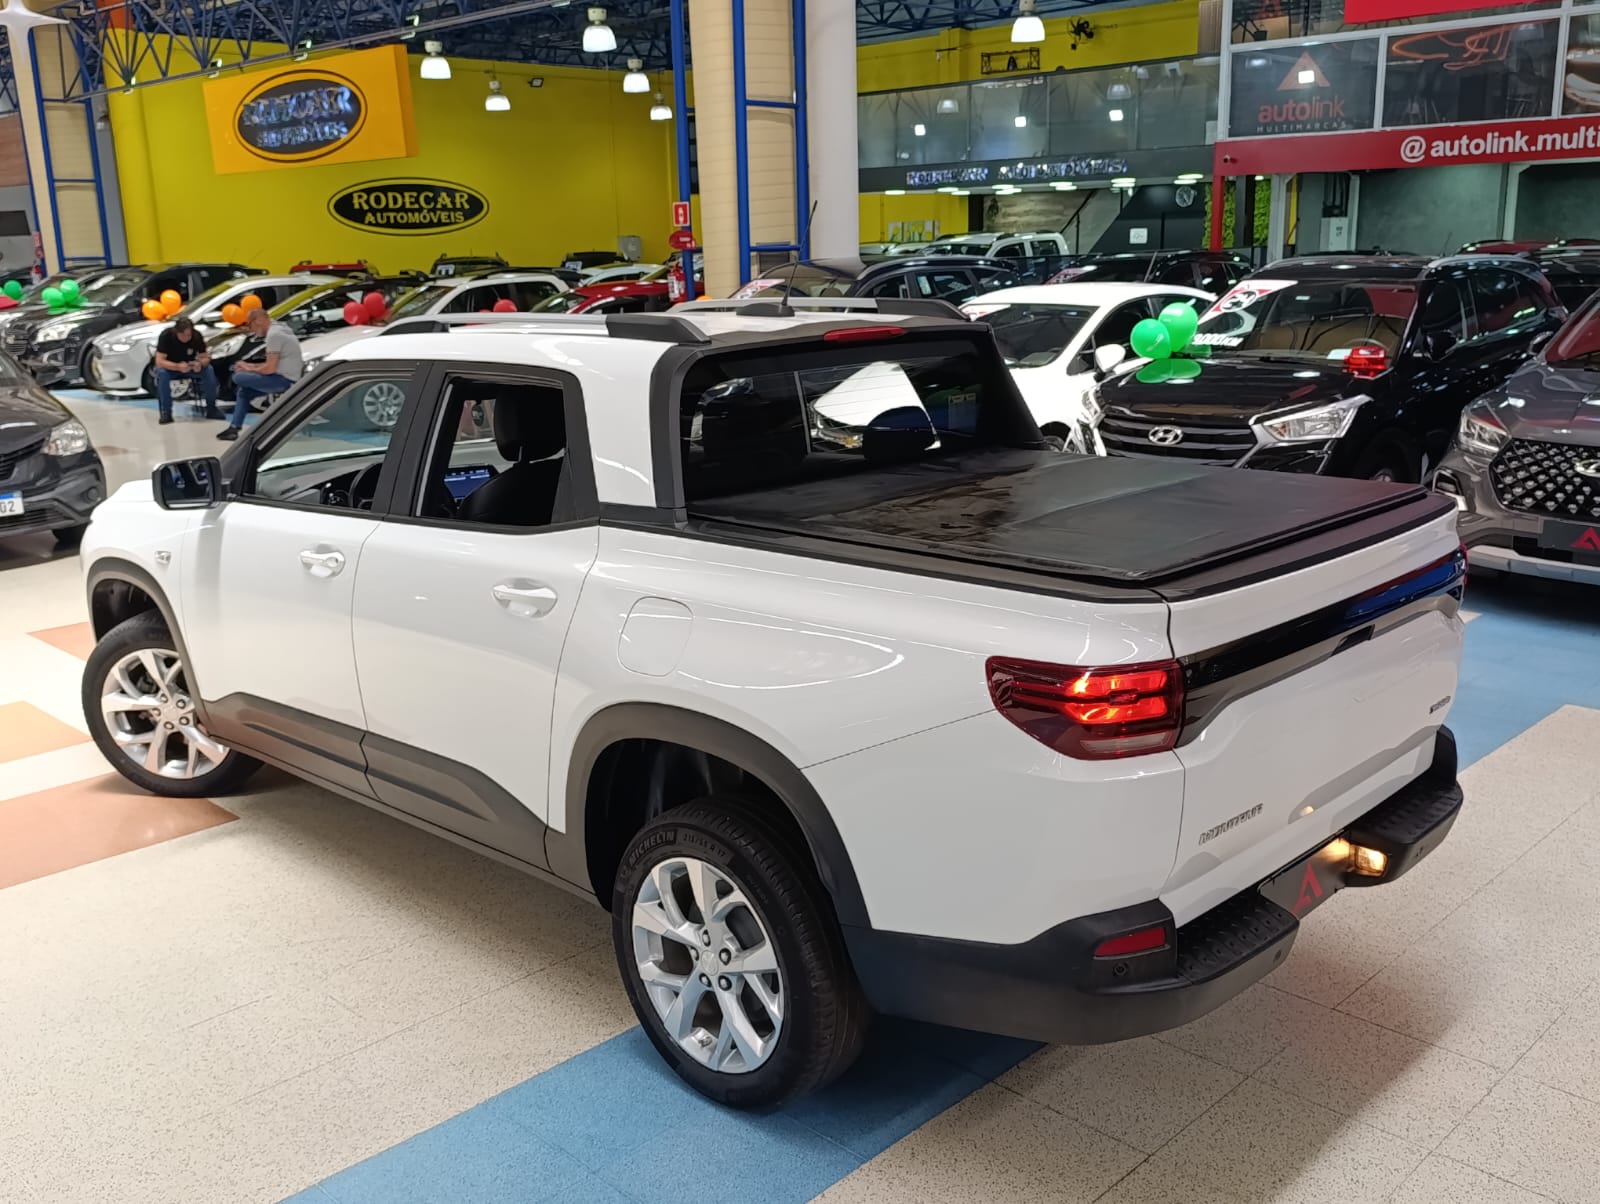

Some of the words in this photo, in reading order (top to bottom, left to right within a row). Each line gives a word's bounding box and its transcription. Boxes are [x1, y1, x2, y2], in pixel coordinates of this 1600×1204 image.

[1258, 96, 1345, 123] autolink
[1257, 121, 1346, 133] MULTIMARCAS
[352, 191, 470, 210] RODECAR
[364, 209, 465, 224] AUTOMÓVEIS
[628, 830, 675, 869] MICHELIN
